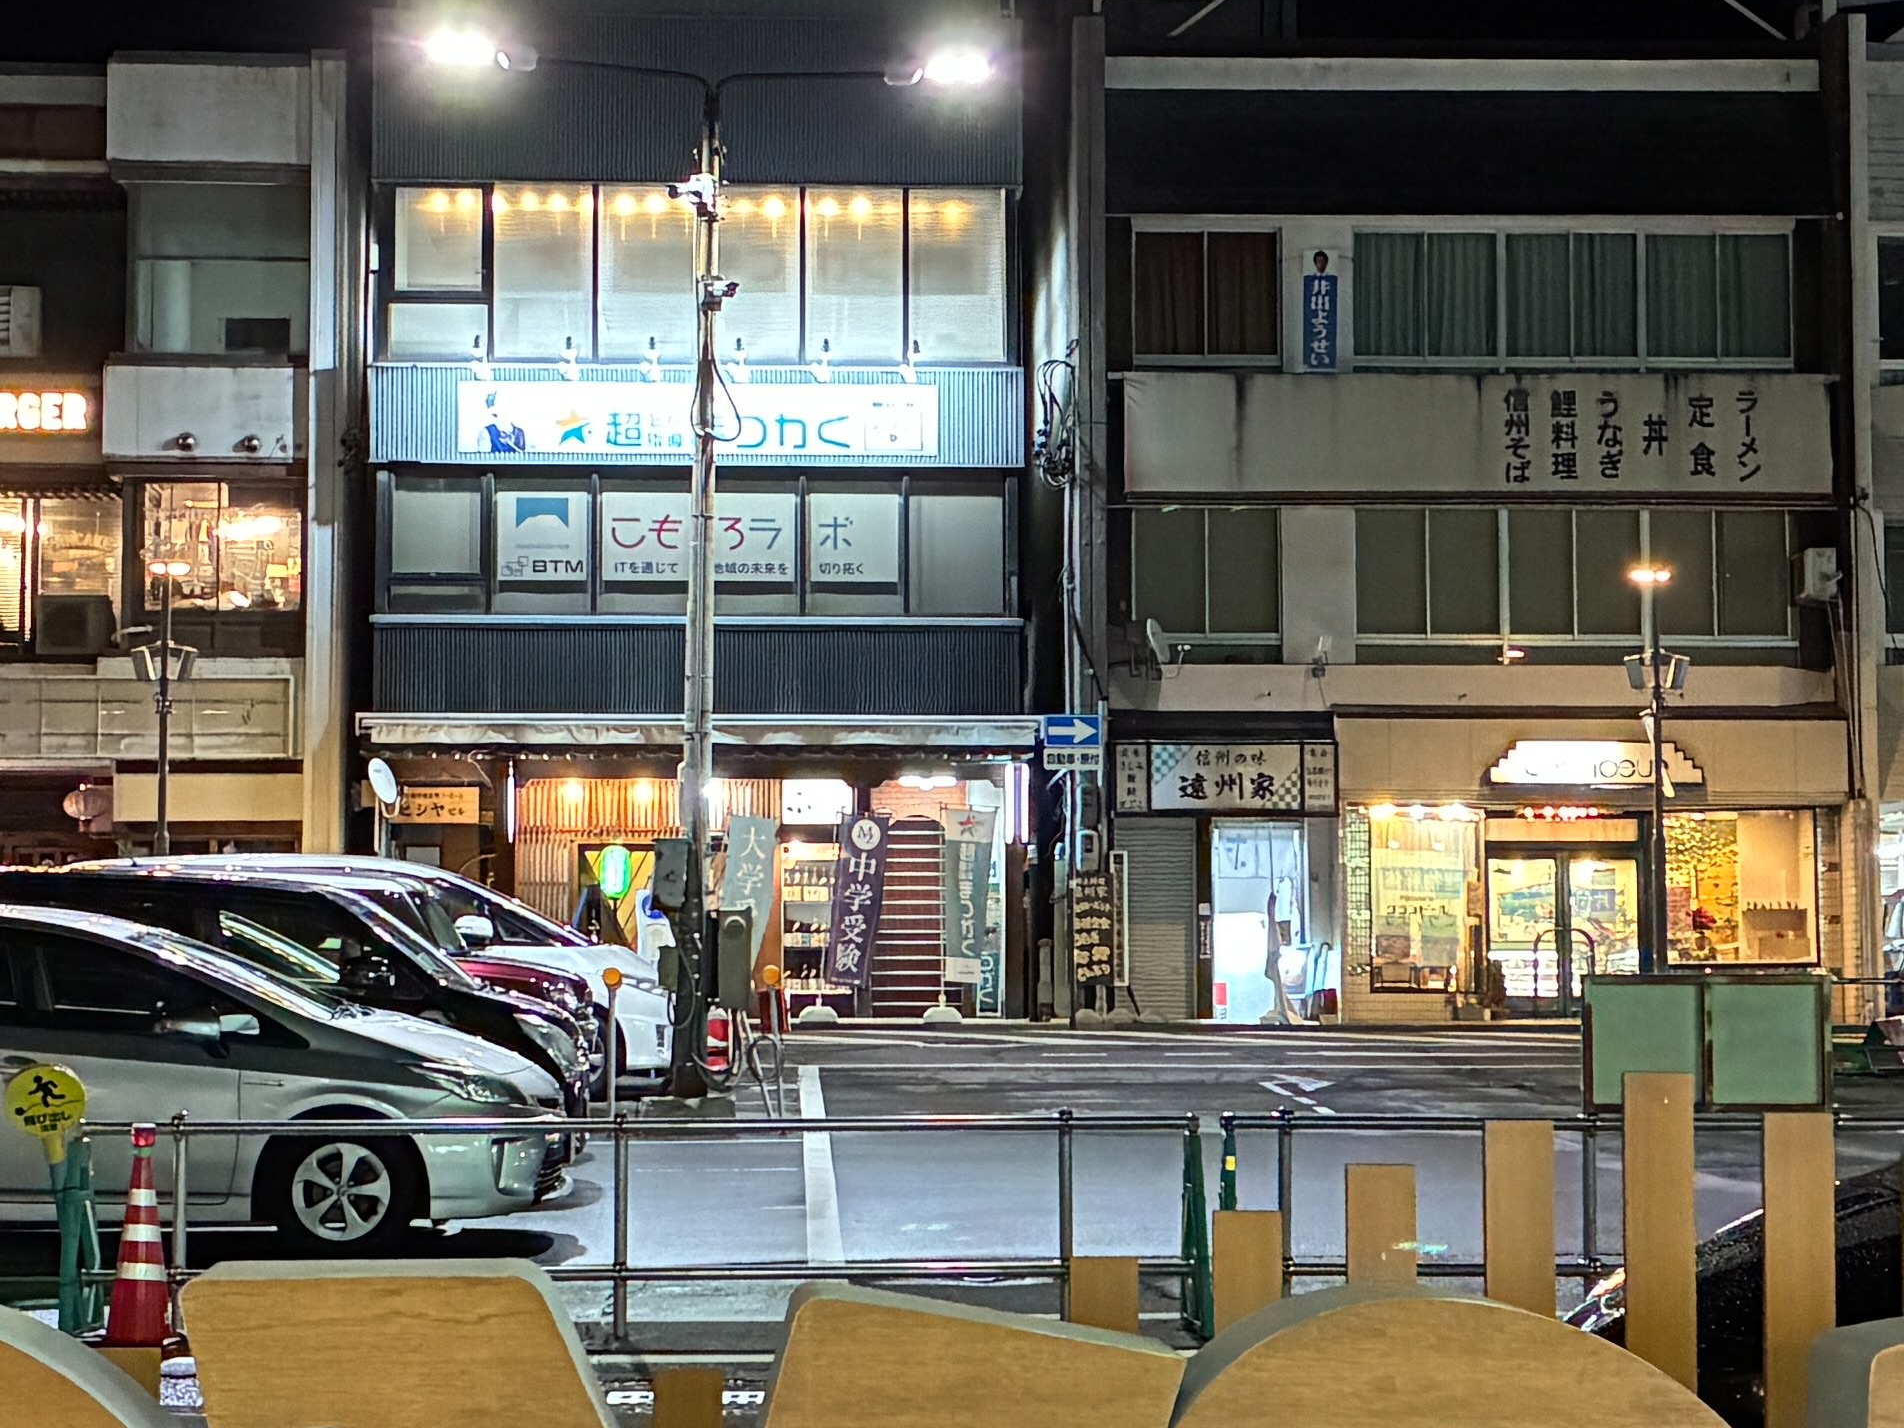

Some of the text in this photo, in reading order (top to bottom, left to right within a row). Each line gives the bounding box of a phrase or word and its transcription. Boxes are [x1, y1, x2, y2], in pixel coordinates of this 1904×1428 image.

[1503, 388, 1532, 484] 信州そば
[1549, 389, 1579, 481] 鯉料理
[1596, 390, 1624, 479] うなぎ
[1687, 393, 1717, 478] 定食
[1735, 390, 1762, 483] ラーメン
[532, 559, 584, 574] BTM
